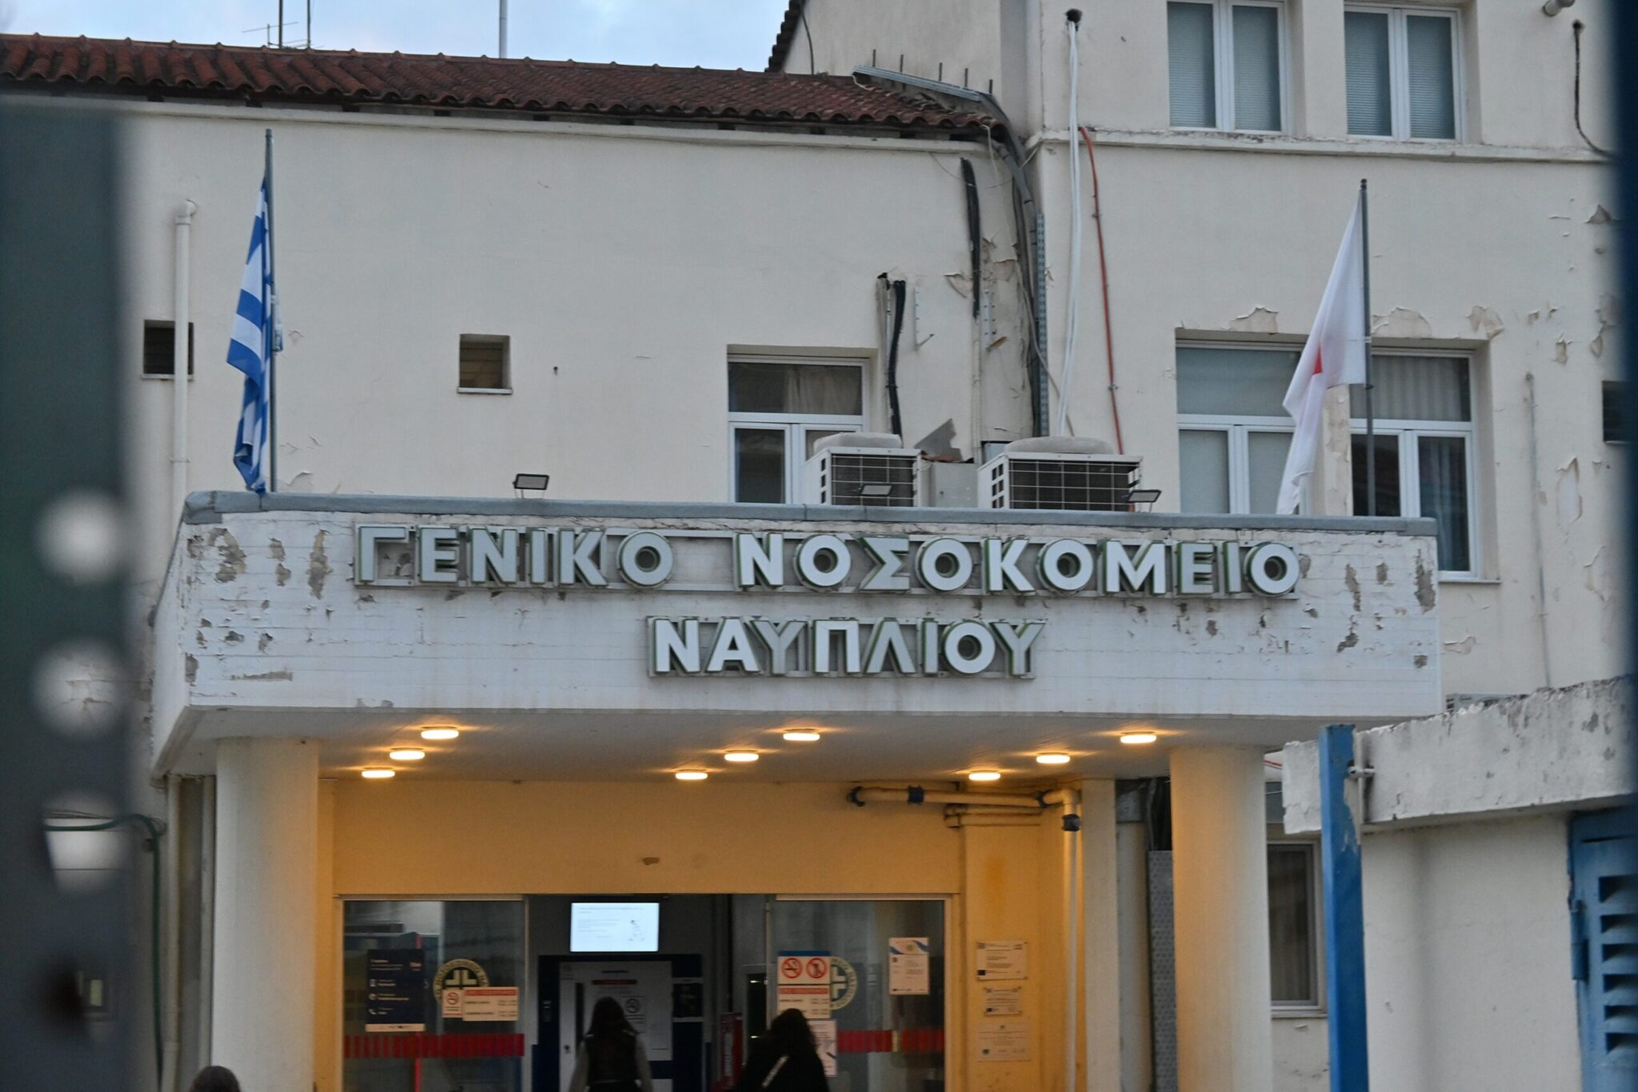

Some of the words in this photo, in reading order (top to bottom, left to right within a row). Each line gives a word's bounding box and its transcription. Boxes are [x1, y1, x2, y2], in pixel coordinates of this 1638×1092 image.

[358, 525, 674, 588] ΓΕΝΙΚΟ
[735, 532, 1301, 596] ΝΟΣΟΚΟΜΕΙΟ
[653, 616, 1045, 676] ΝΑΥΠΛΙΟΥ
